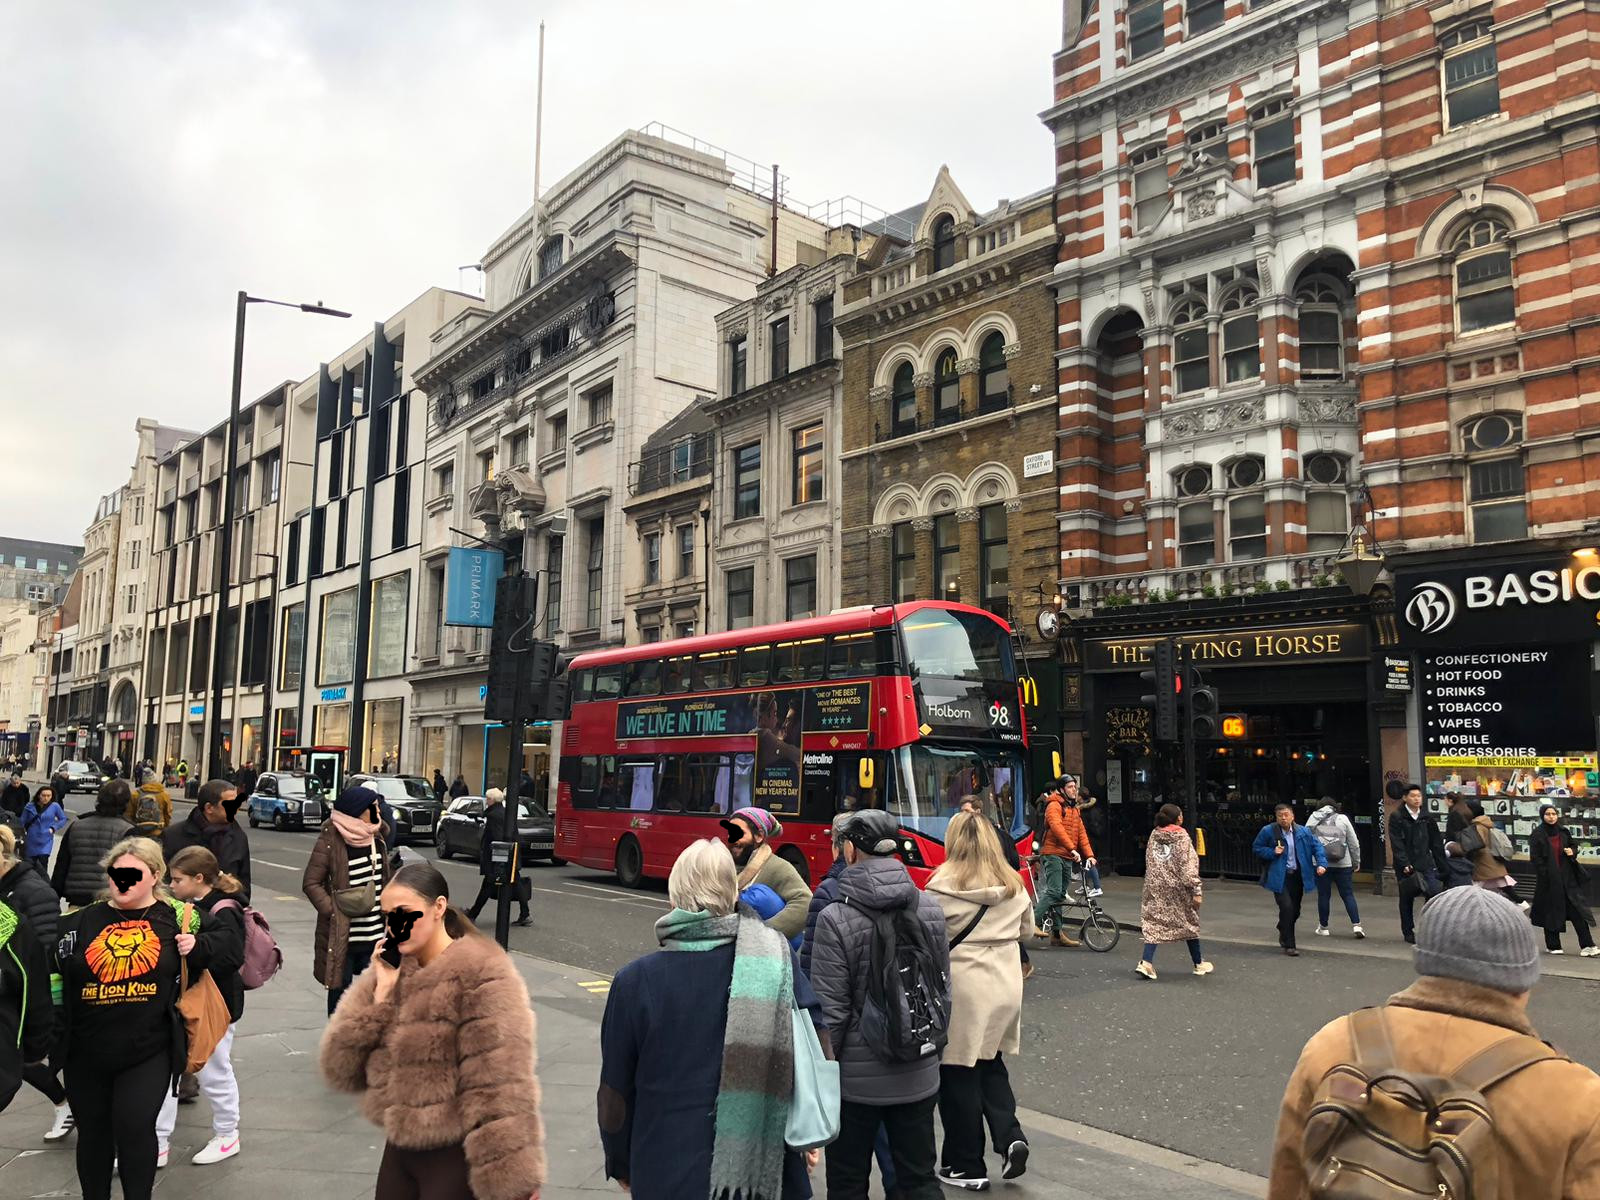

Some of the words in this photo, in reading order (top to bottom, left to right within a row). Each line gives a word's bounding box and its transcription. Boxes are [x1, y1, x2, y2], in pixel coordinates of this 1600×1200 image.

[1026, 455, 1044, 463] OXFORD
[1026, 461, 1042, 470] STREET
[470, 555, 482, 619] PRIMARK
[1465, 566, 1600, 608] BASIC
[1108, 645, 1151, 664] THE
[1176, 640, 1242, 660] YING
[1254, 634, 1341, 657] HORSE
[1436, 652, 1548, 666] CONFECTIONERY
[1436, 671, 1462, 681] HOT
[1465, 670, 1502, 680] FOOD
[322, 687, 347, 700] PRIMARK
[832, 689, 842, 697] THE
[843, 688, 857, 696] BEST
[1436, 686, 1486, 696] DRINKS
[830, 697, 861, 706] ROMANCES
[928, 704, 971, 719] Holborn
[1438, 702, 1502, 712] TOBACCO
[989, 705, 1008, 726] 98
[626, 715, 646, 735] WE
[648, 713, 675, 734] LIVE
[678, 712, 691, 733] IN
[694, 710, 727, 732] TIME
[1222, 718, 1245, 736] 06
[1438, 718, 1481, 728] VAPES
[1119, 728, 1137, 737] BAR
[1439, 735, 1490, 745] MOBILE
[1440, 747, 1537, 757] ACCESSORIES
[803, 753, 834, 765] Metroline
[1477, 757, 1501, 766] MONEY
[1503, 757, 1540, 766] EXCHANGE
[762, 779, 768, 787] IN
[768, 779, 793, 787] CINEMAS
[756, 788, 768, 796] NEW
[768, 788, 787, 796] YEAR'S
[788, 788, 799, 796] DAY
[82, 987, 98, 998] THE
[99, 984, 126, 999] LION
[127, 981, 157, 997] KING
